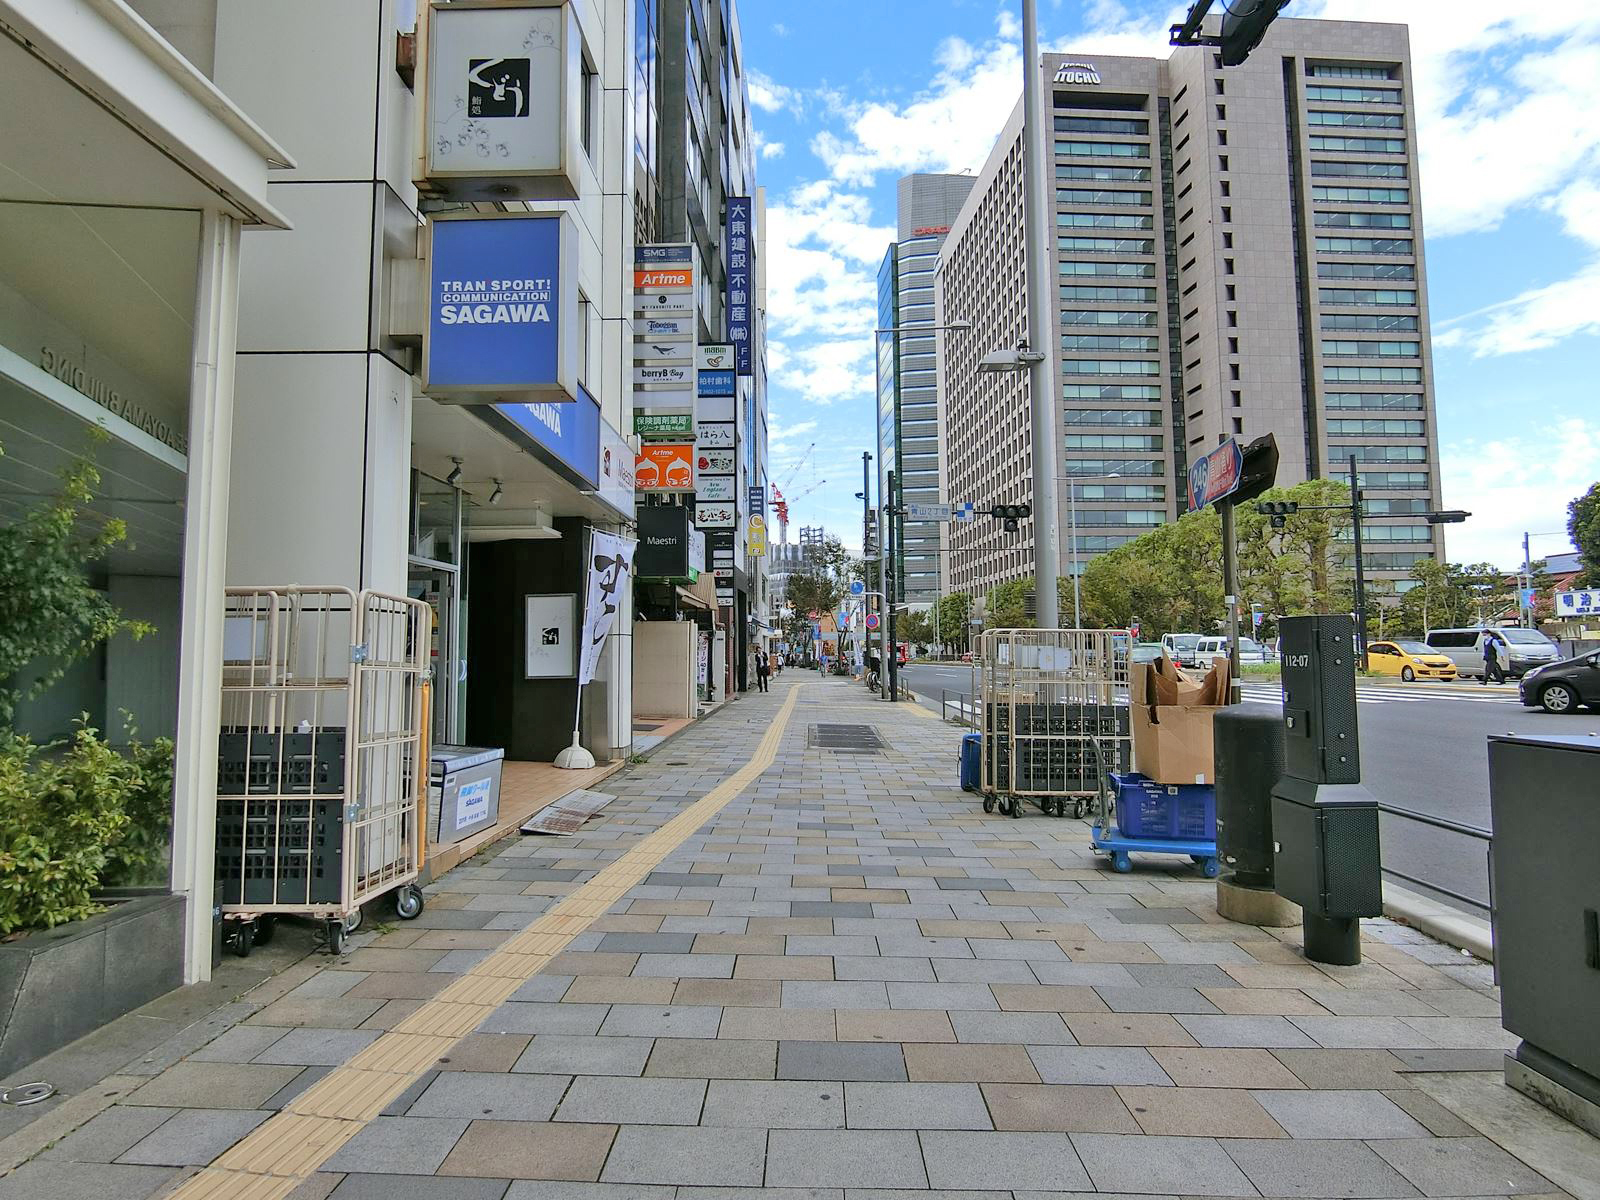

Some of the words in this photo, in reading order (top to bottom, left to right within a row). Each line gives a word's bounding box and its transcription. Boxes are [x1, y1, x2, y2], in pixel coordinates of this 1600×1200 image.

[1053, 66, 1101, 84] ITOCHU
[643, 249, 666, 257] SMG
[442, 291, 549, 302] COMMUNICATION
[440, 303, 551, 324] SAGAWA
[1193, 463, 1208, 494] 246
[646, 535, 677, 545] Maestri
[1285, 655, 1309, 667] 112-07
